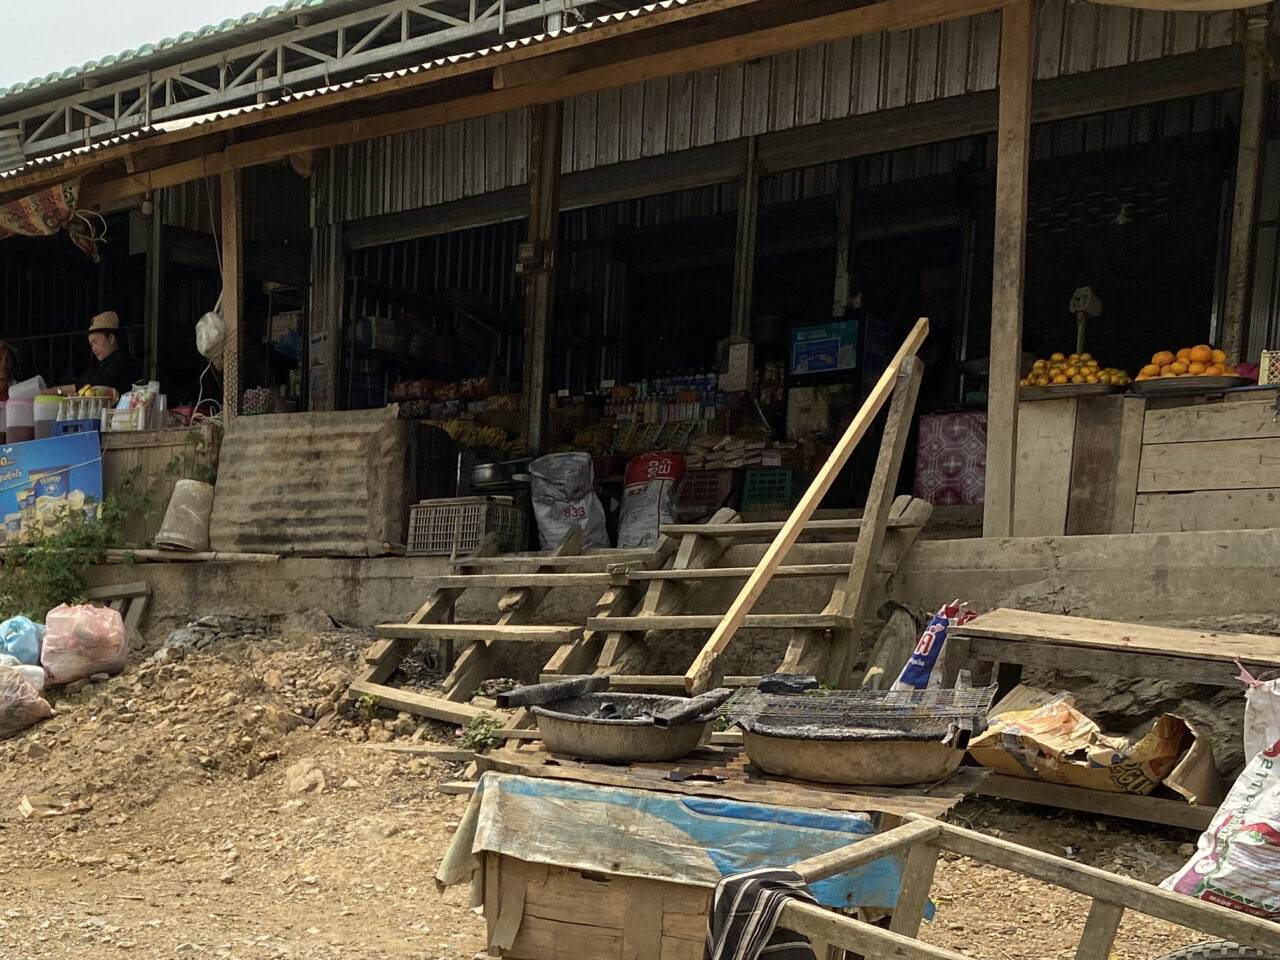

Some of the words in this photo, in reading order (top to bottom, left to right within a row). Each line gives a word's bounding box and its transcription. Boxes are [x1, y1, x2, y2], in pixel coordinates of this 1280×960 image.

[39, 476, 62, 485] TEAPOT
[563, 506, 586, 518] 833
[1251, 758, 1274, 789] 211
[1209, 896, 1232, 908] MADE
